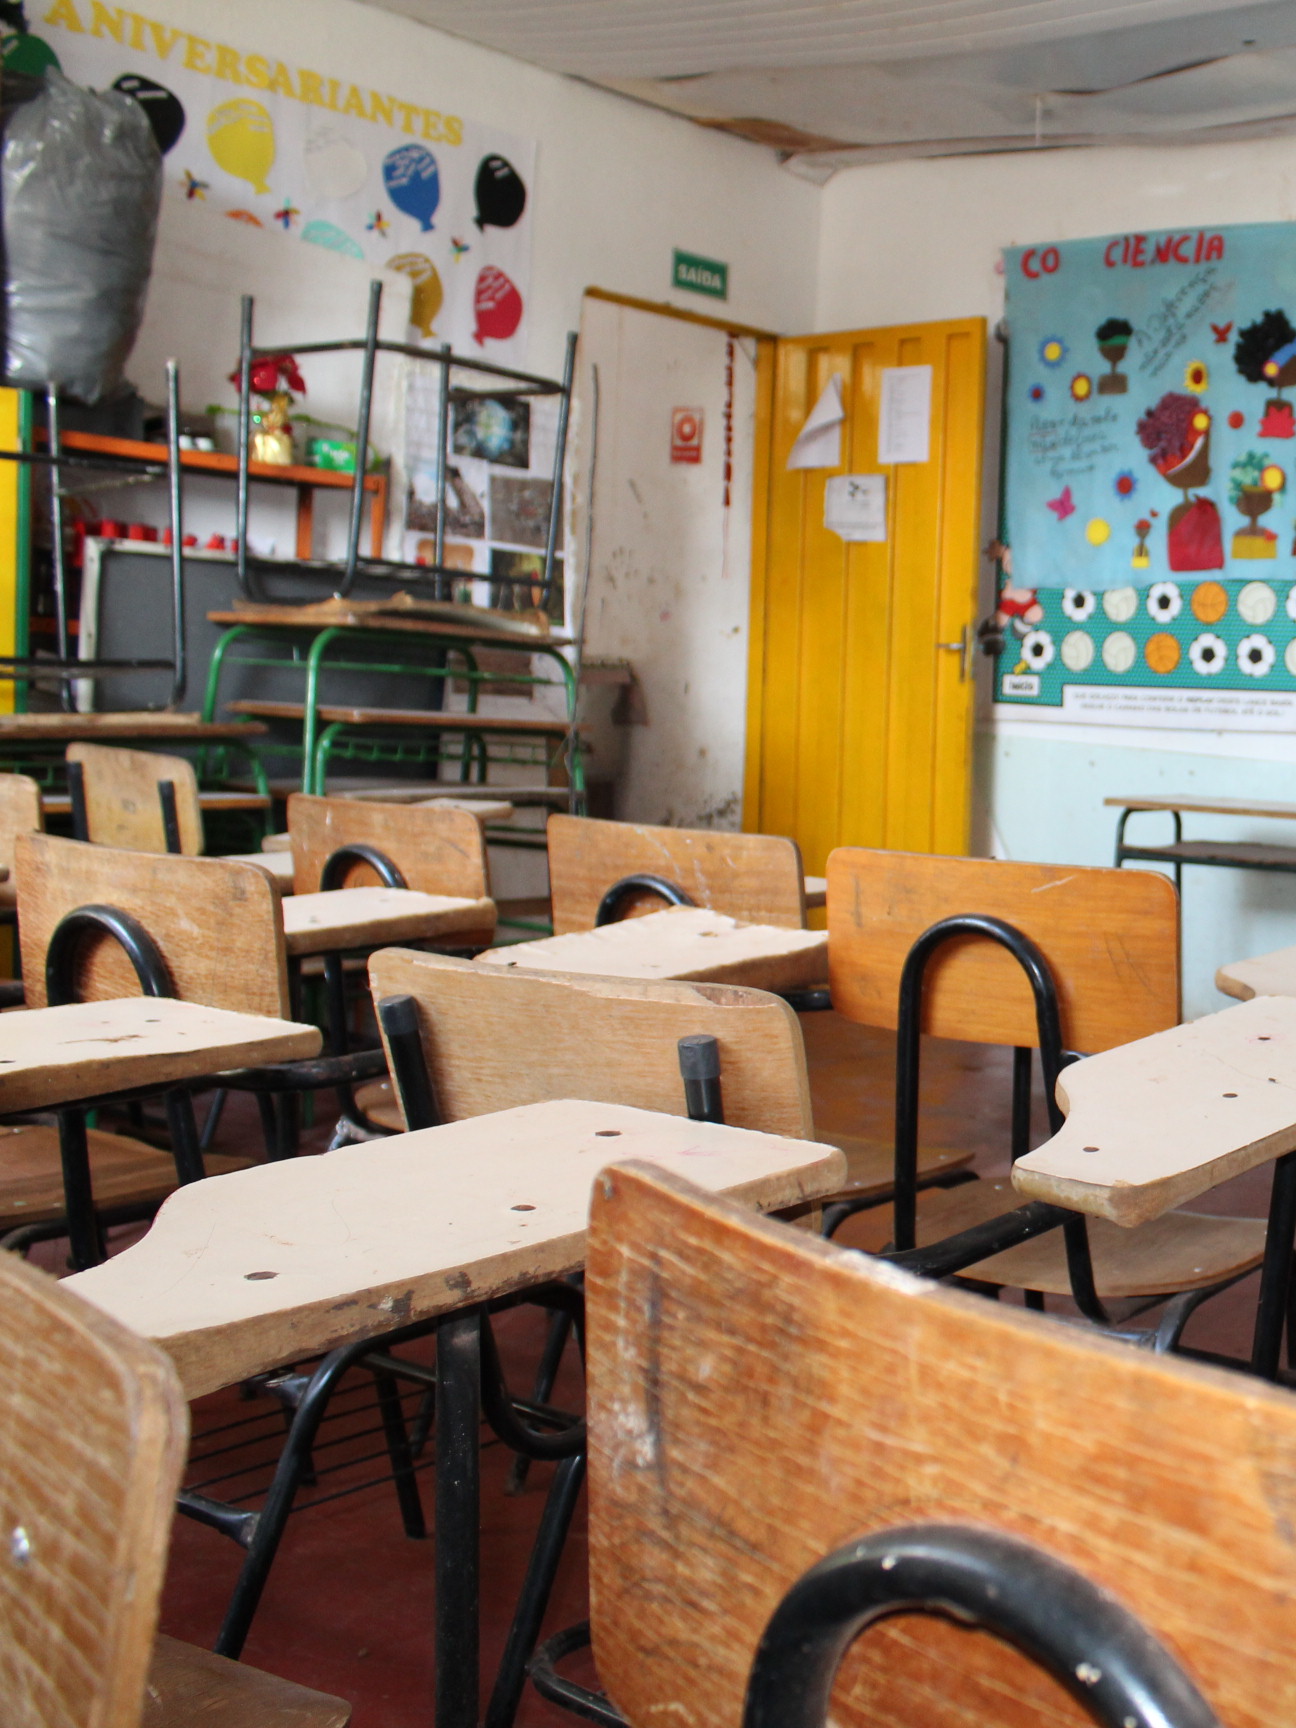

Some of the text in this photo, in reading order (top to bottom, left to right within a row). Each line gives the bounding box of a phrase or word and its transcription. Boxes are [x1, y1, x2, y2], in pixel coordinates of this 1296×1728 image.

[44, 0, 464, 147] ANIVERSARIANTES
[677, 263, 721, 290] SAÍDA
[1020, 231, 1224, 279] CO CIENCIA
